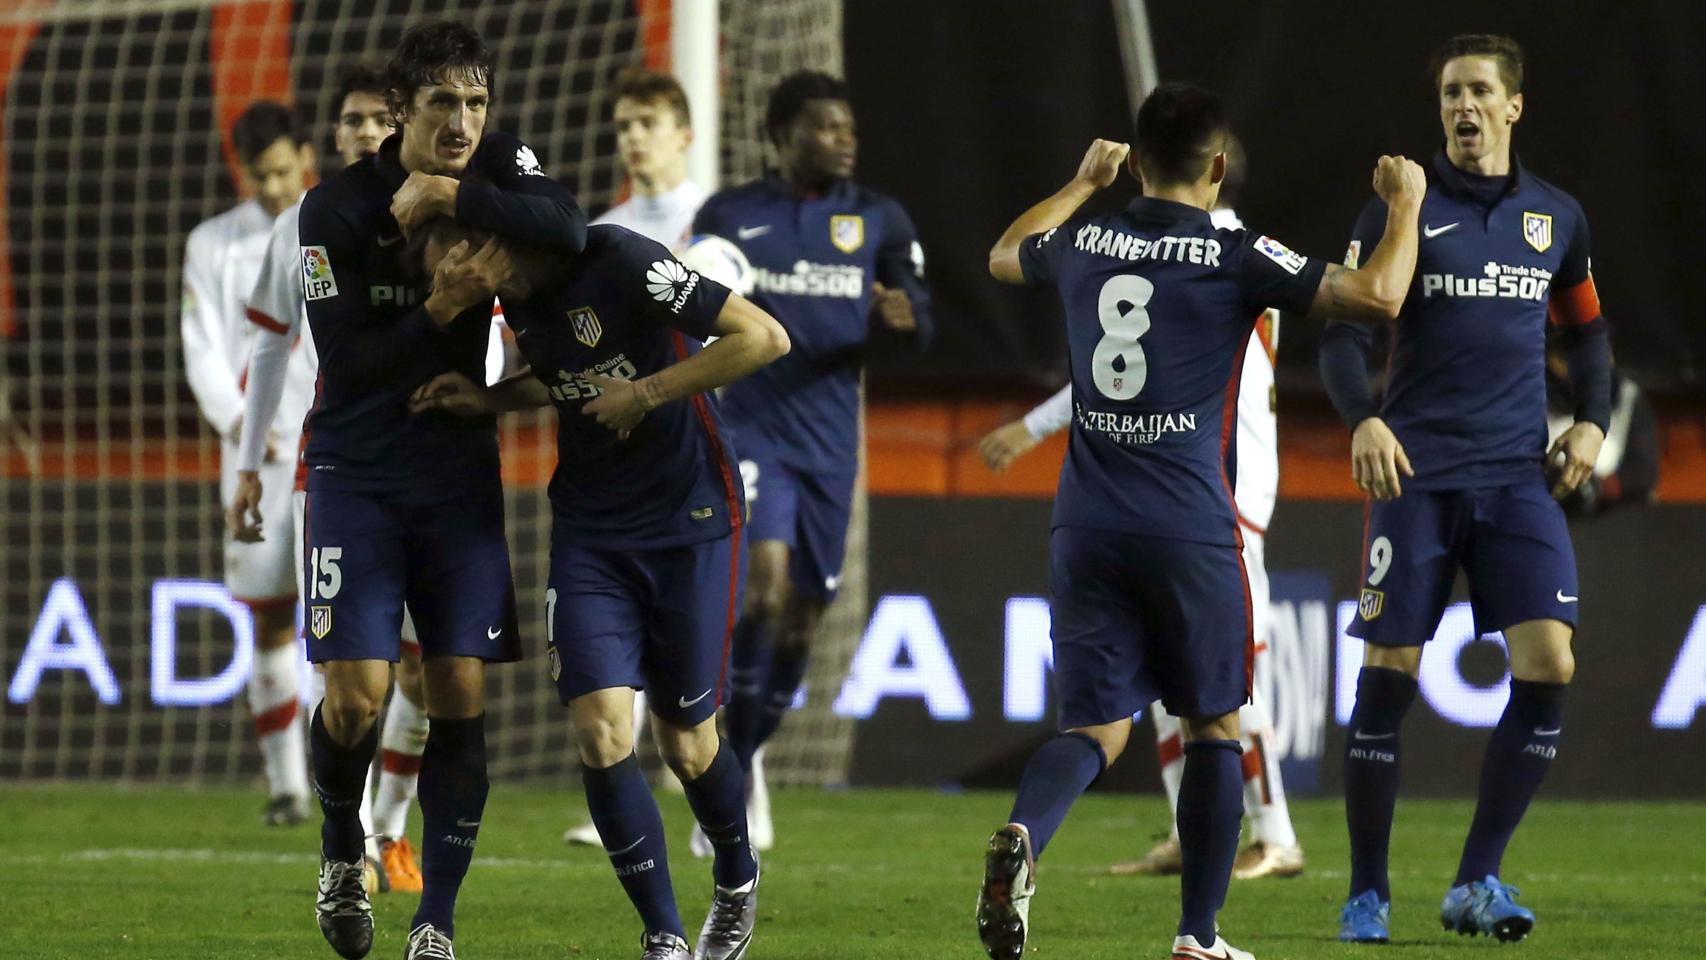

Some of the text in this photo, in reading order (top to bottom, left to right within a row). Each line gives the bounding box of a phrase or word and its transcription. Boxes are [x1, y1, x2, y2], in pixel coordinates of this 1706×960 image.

[1501, 264, 1529, 276] Trade
[306, 280, 332, 299] LFP
[1423, 272, 1549, 301] Plus500
[1091, 273, 1155, 401] 8
[594, 352, 626, 373] Online
[1127, 433, 1155, 444] FIRE
[310, 546, 343, 600] 15
[1368, 535, 1393, 587] 9
